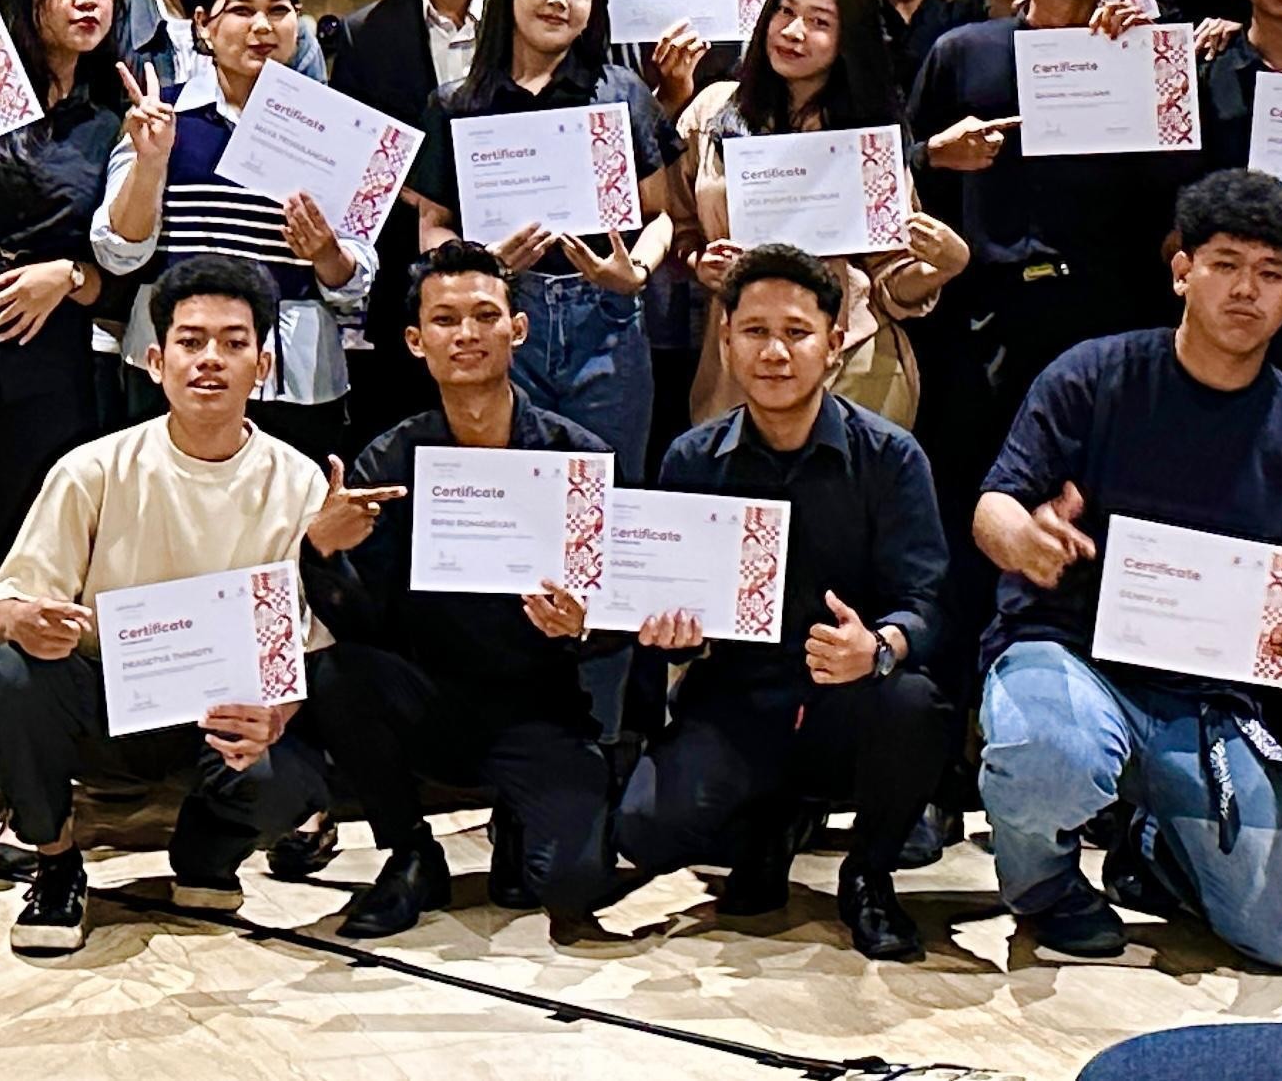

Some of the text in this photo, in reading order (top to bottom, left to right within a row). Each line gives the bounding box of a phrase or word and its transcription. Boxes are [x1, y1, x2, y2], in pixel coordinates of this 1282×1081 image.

[265, 97, 327, 134] Certificate
[471, 147, 537, 163] Certificate
[432, 485, 505, 499] Certificate
[610, 525, 682, 543] Certificate
[1123, 556, 1203, 581] Certificate
[118, 618, 193, 641] Certificate
